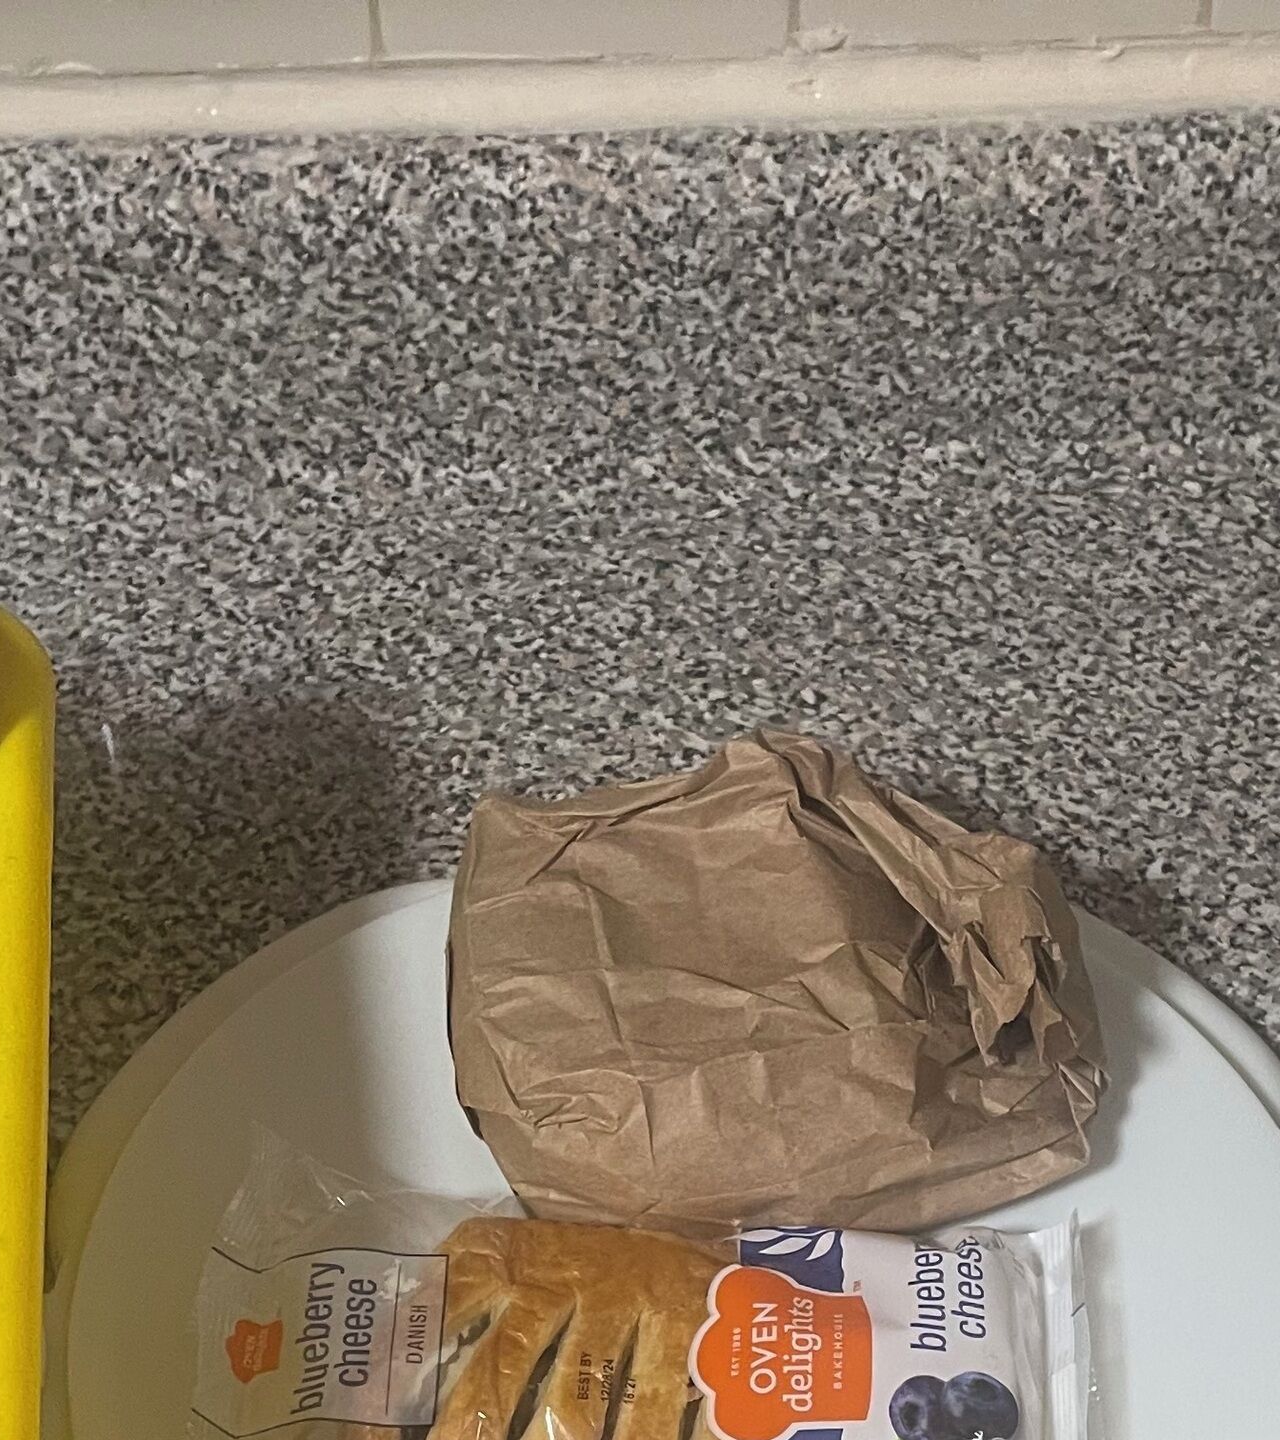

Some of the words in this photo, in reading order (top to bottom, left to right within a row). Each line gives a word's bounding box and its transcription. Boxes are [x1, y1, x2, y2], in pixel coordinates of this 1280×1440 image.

[290, 1262, 345, 1415] blueberry
[333, 1278, 378, 1387] cheese
[405, 1304, 428, 1365] DANISH
[579, 1351, 592, 1367] BY
[730, 1357, 740, 1377] EST
[749, 1302, 779, 1395] OVEN
[782, 1297, 822, 1413] delights
[577, 1369, 592, 1401] BEST
